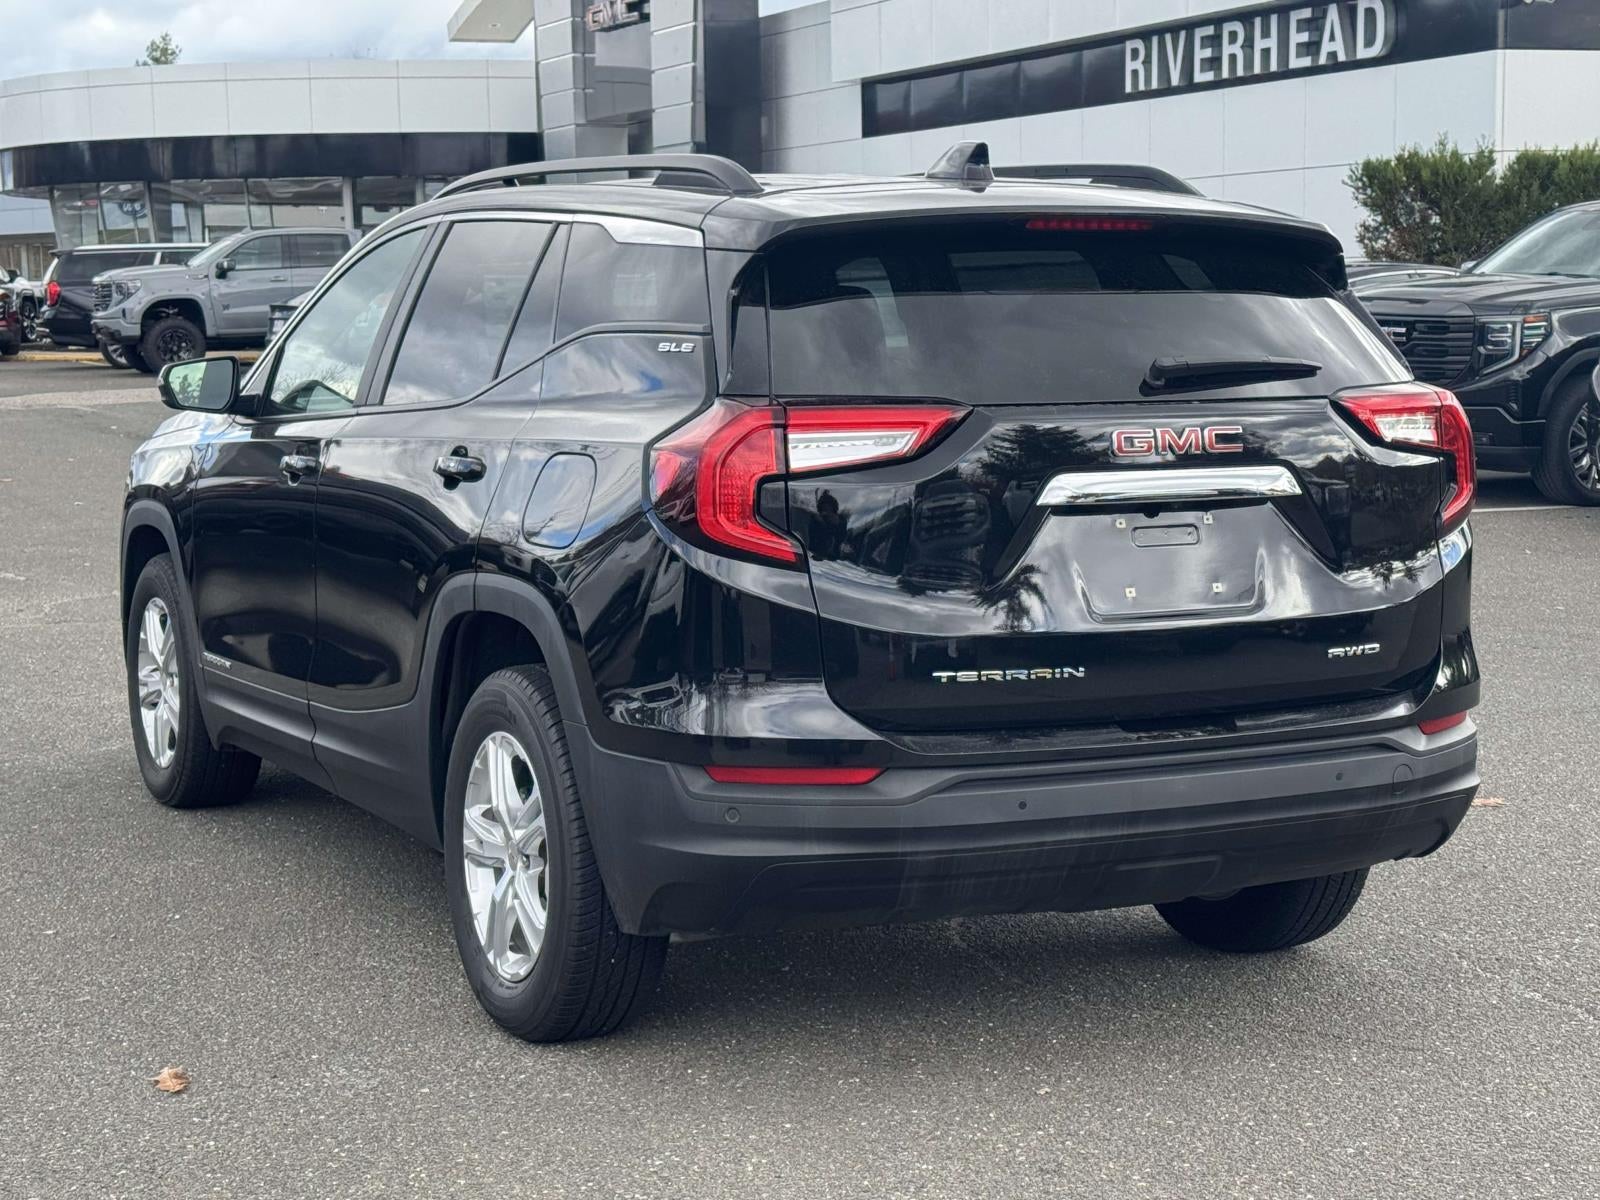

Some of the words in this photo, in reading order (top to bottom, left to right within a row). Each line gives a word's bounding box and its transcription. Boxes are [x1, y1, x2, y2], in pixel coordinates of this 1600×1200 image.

[1124, 0, 1386, 93] RIVERHEAD
[657, 342, 695, 352] SLE
[1112, 426, 1244, 457] GMC
[1327, 643, 1381, 659] AWD
[932, 667, 1085, 683] TERRAIN
